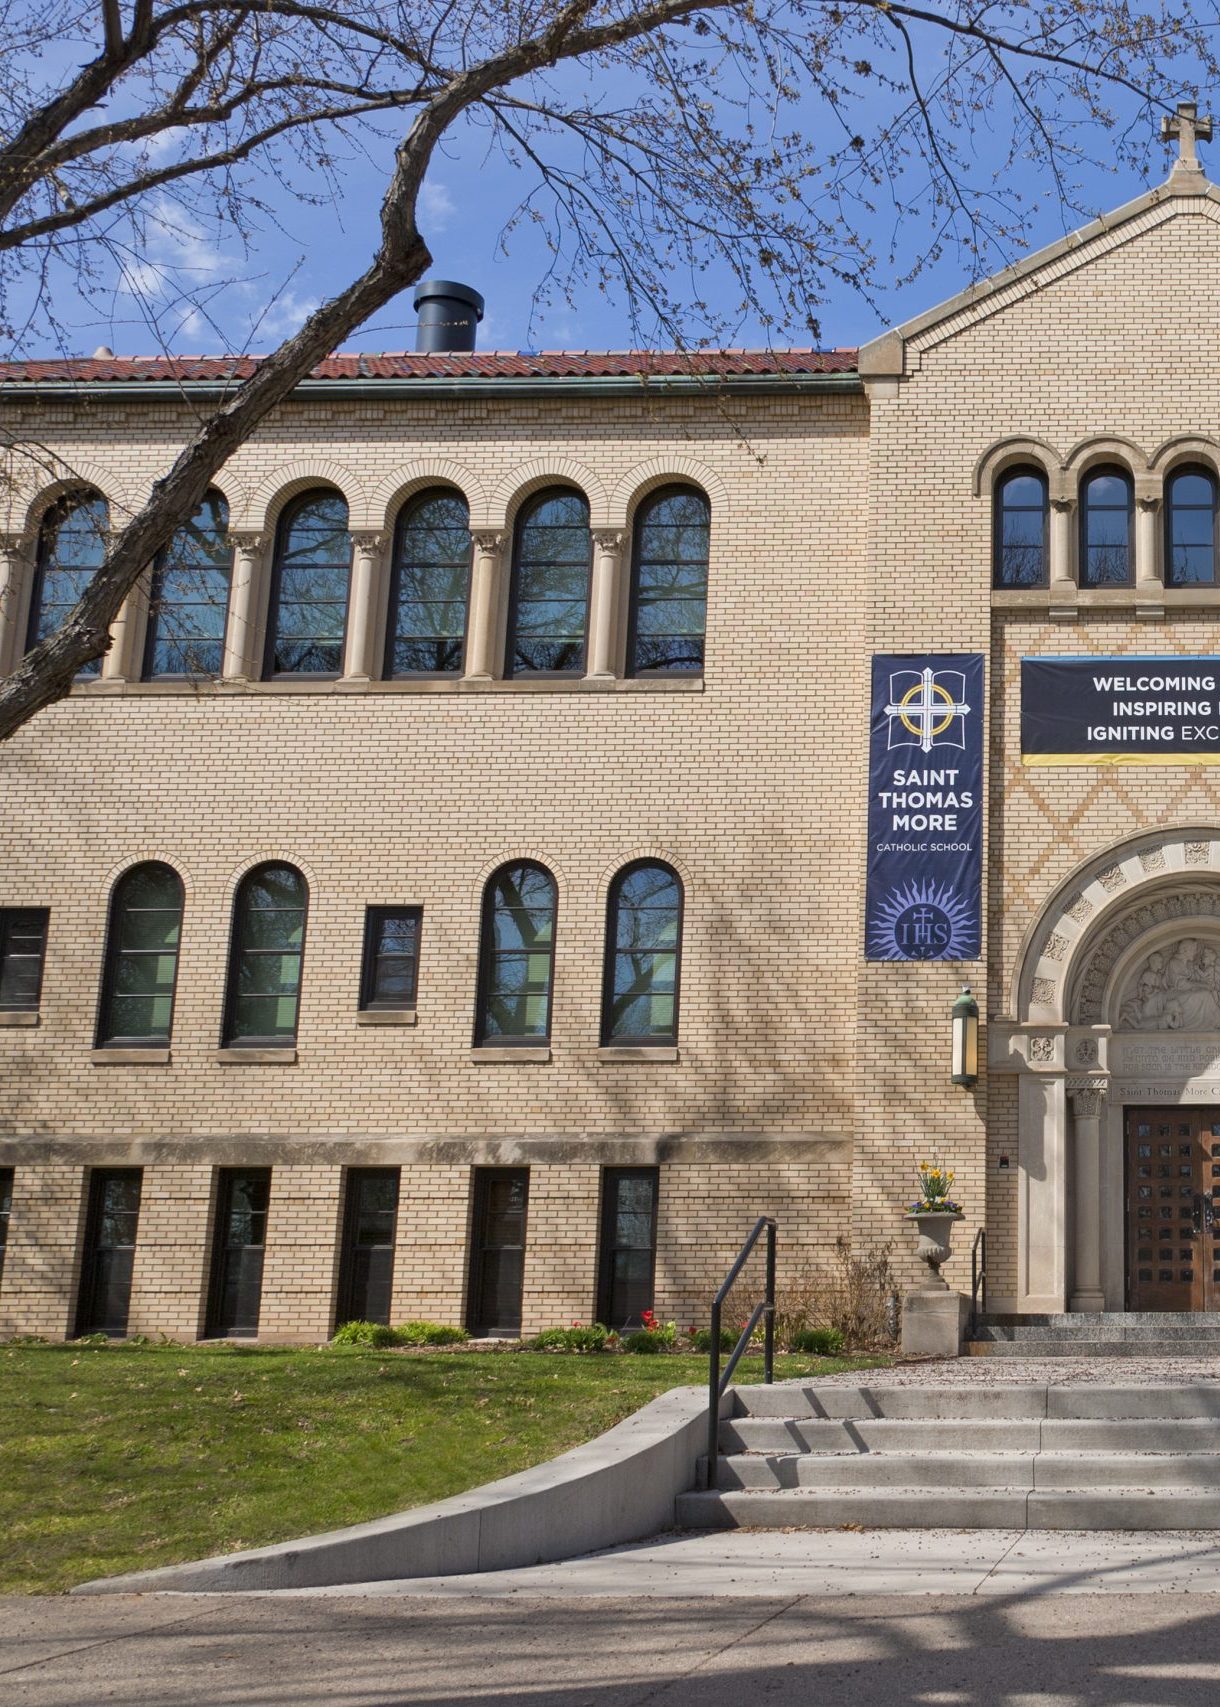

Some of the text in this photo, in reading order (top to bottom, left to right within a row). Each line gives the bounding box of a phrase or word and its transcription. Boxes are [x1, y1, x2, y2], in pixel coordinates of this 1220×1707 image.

[1093, 677, 1215, 691] WELCOMING
[1114, 702, 1211, 715] INSPIRING
[1088, 726, 1174, 740] IGNITING
[894, 770, 959, 785] SAINT
[879, 792, 972, 808] THOMAS
[893, 815, 957, 830] MORE
[877, 843, 972, 851] CATHOLIC SCHOOL
[901, 924, 947, 945] IHS
[1120, 1087, 1143, 1096] Saint
[1147, 1087, 1181, 1096] Thomas
[1185, 1087, 1208, 1096] More
